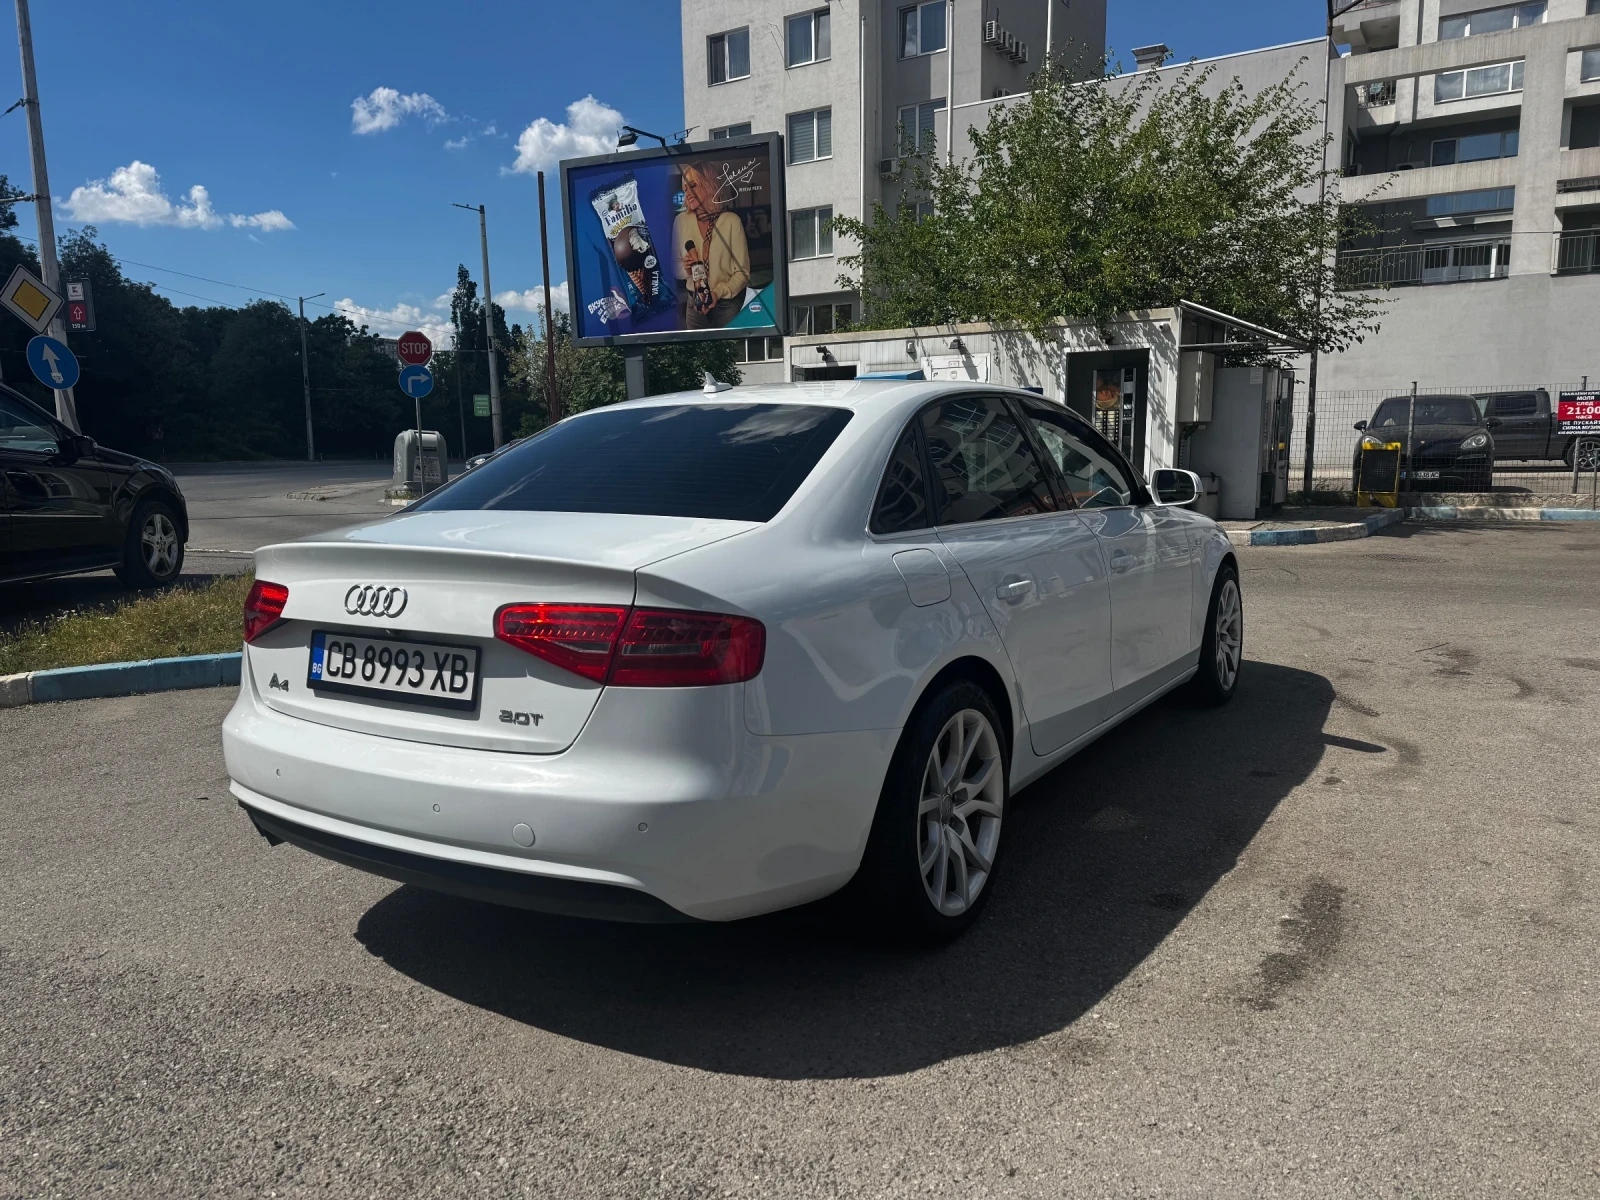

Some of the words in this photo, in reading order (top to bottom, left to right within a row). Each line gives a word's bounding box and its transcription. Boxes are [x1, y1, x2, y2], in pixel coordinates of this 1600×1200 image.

[604, 203, 637, 227] Familia
[651, 270, 660, 296] VANILLA
[401, 342, 428, 355] STOP
[1566, 406, 1600, 415] 21:00
[311, 662, 322, 674] BG
[326, 640, 357, 679] CB
[361, 645, 425, 688] 8993
[430, 651, 469, 693] XB
[268, 672, 290, 693] A4
